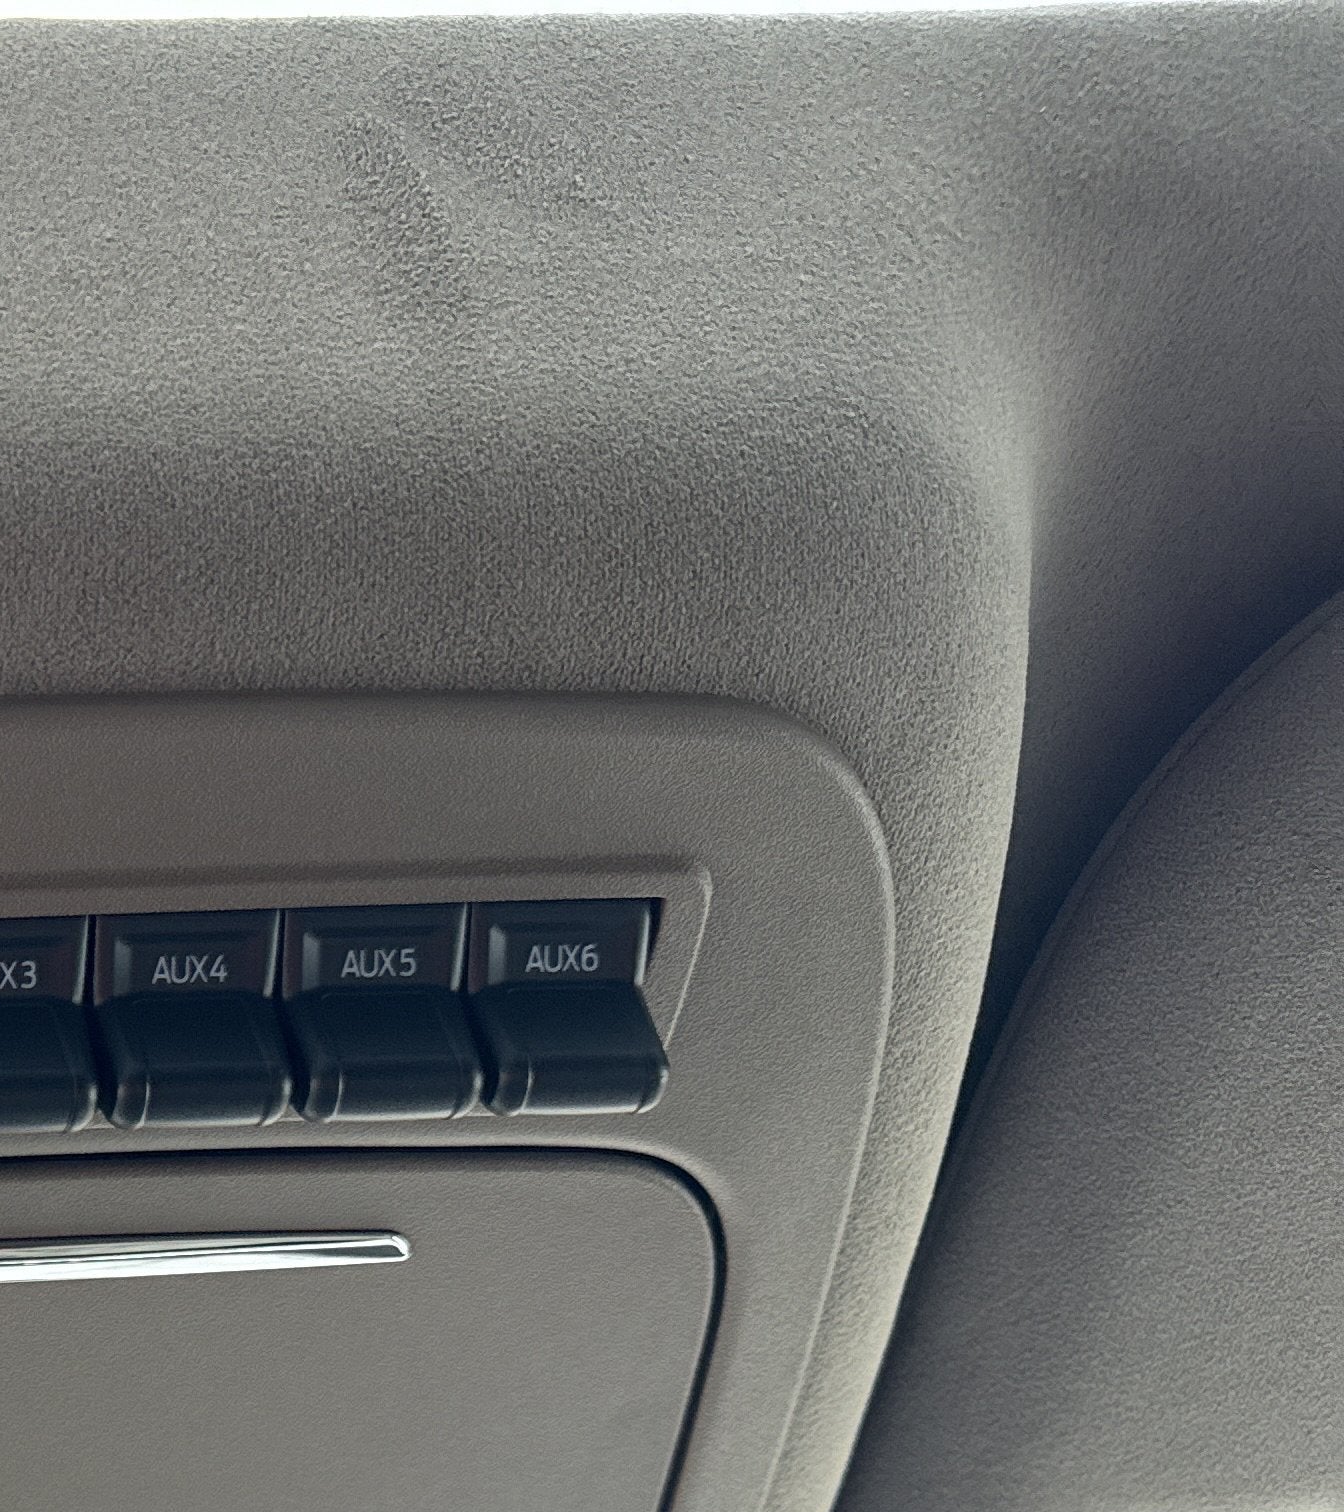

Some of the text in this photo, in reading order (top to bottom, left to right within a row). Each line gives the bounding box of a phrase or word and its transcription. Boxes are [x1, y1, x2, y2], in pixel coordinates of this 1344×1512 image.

[151, 954, 229, 985] AUX4
[340, 948, 417, 978] AUX5
[524, 942, 599, 973] AUX6
